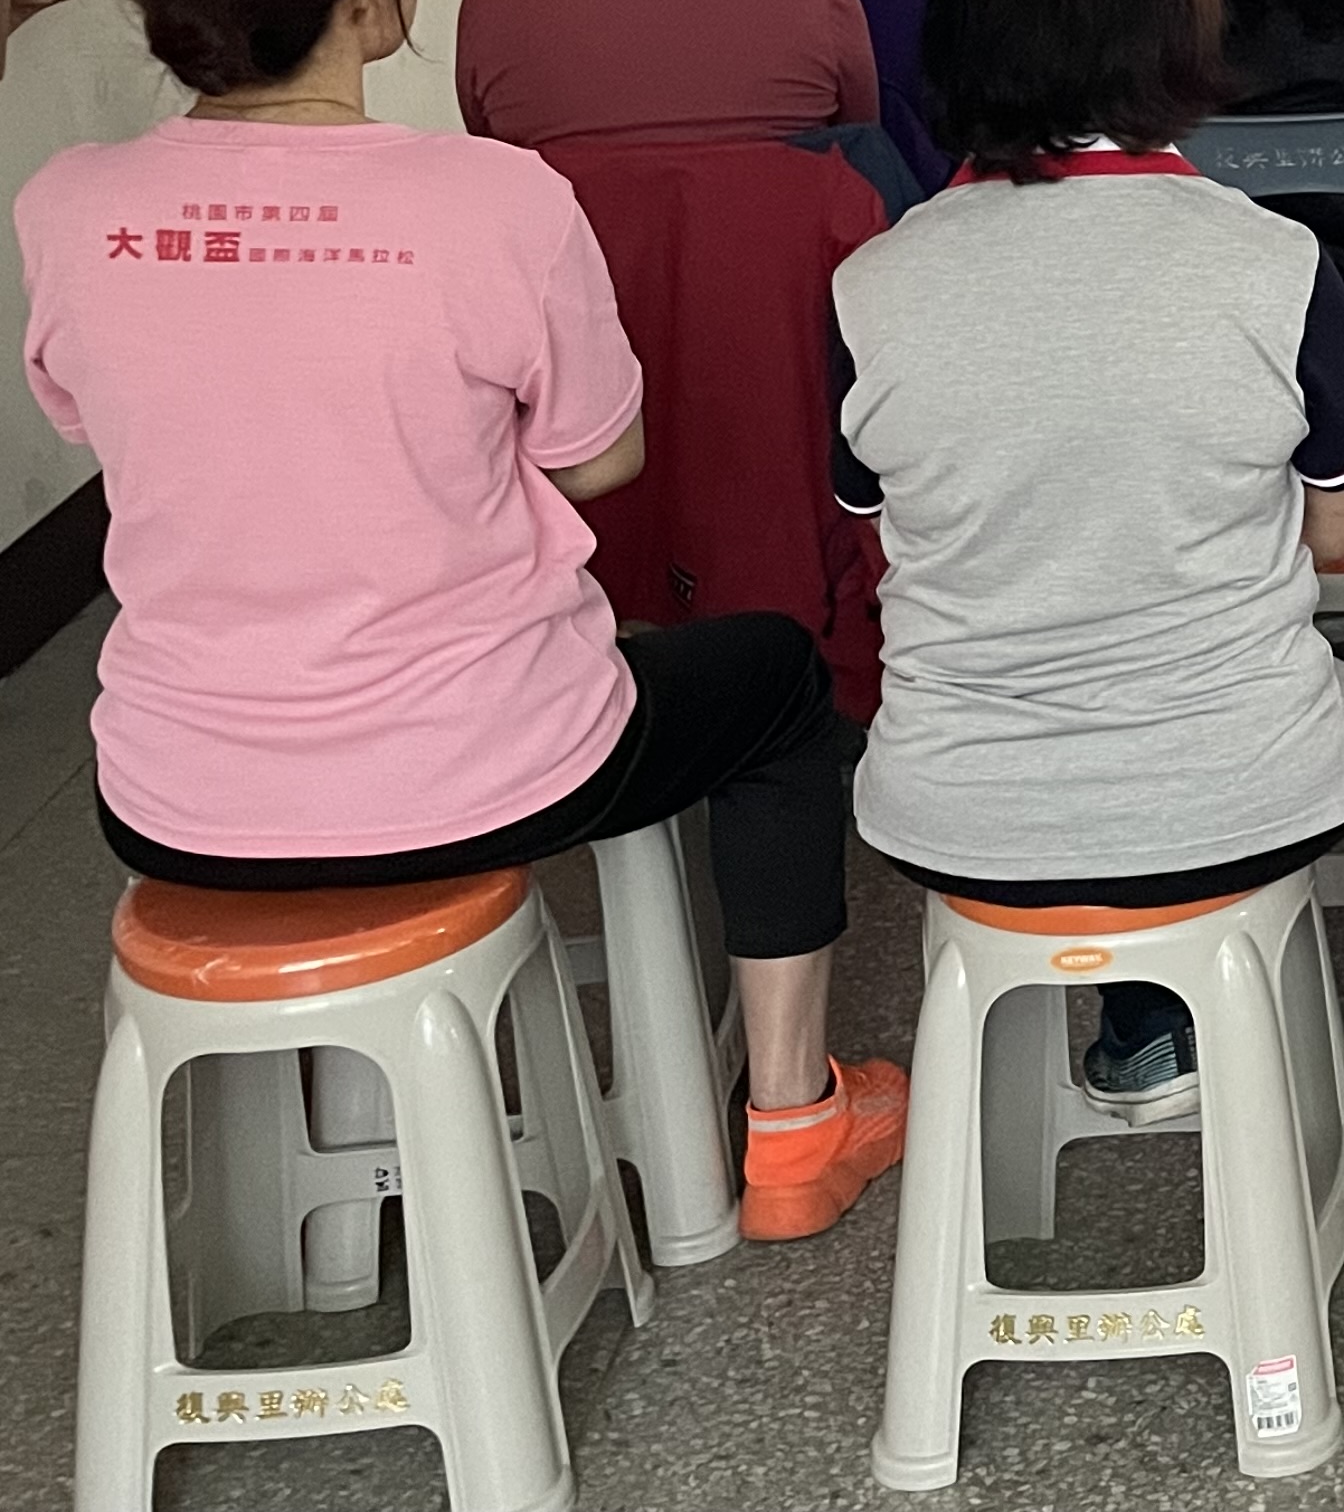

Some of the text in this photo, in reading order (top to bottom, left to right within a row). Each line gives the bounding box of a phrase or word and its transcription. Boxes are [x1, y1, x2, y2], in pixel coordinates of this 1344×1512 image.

[182, 203, 339, 222] 桃園市第四屆
[988, 1304, 1206, 1347] 復興里辦公處
[173, 1377, 410, 1425] 復興里辦公處
